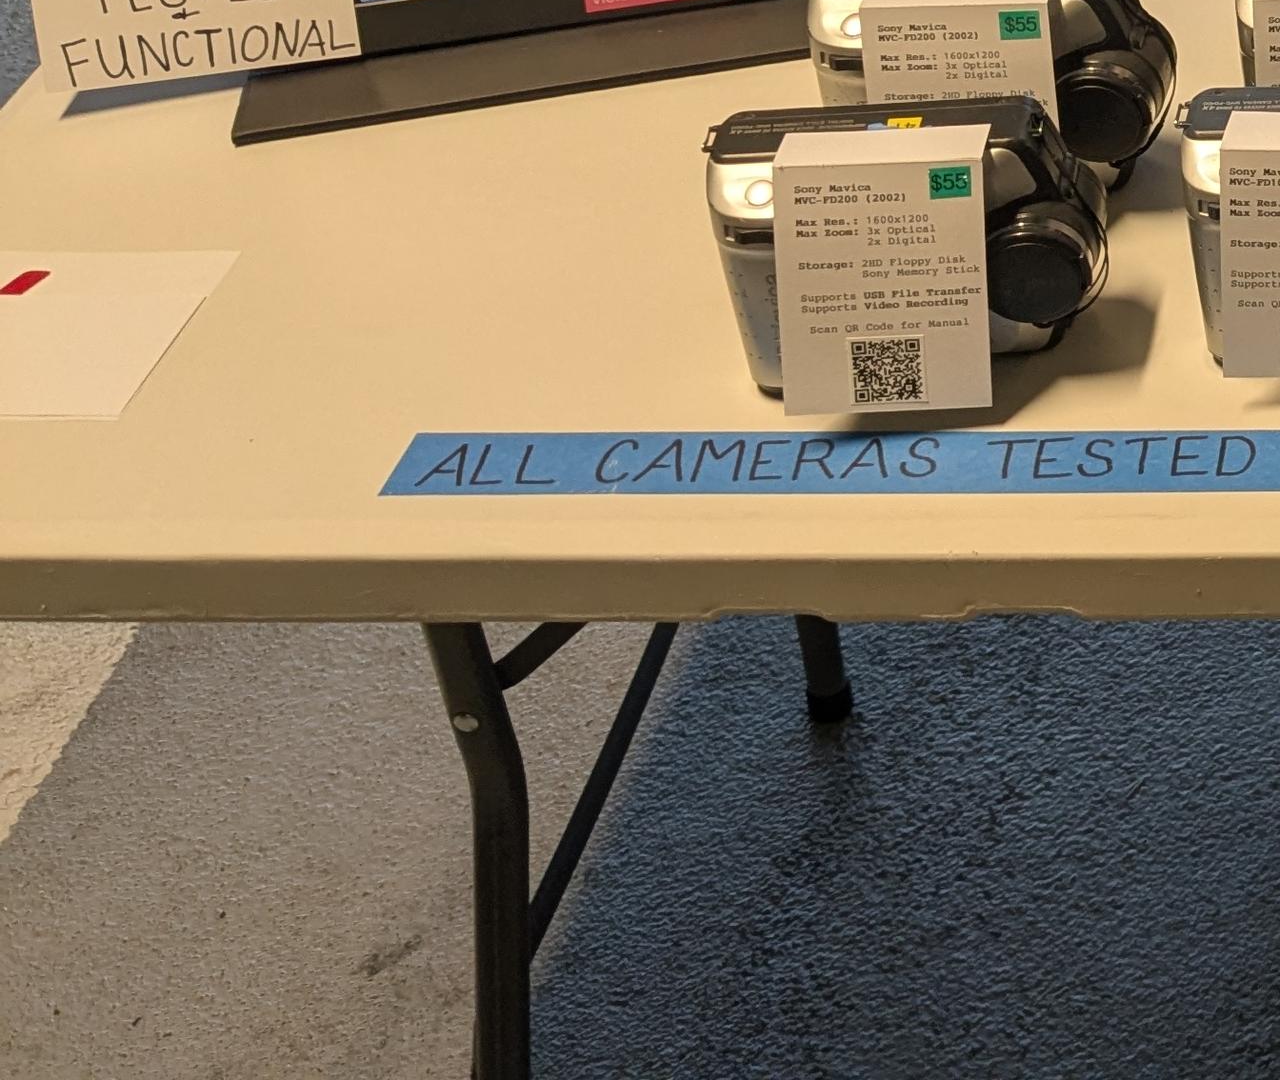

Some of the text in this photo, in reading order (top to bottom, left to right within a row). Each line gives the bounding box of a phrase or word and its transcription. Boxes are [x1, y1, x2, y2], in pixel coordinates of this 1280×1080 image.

[878, 25, 903, 33] Sony
[1004, 16, 1037, 34] $55
[878, 32, 978, 41] MVC-FD200 (2002)
[59, 19, 356, 87] FUNCTIONAL
[1229, 168, 1256, 177] Sony
[930, 172, 968, 193] $55
[794, 184, 871, 194] Sony Mavica
[794, 193, 905, 205] MVC-FD200 (2002)
[414, 442, 556, 488] ALL
[594, 437, 938, 484] CAMERAS
[986, 435, 1255, 479] TESTED
